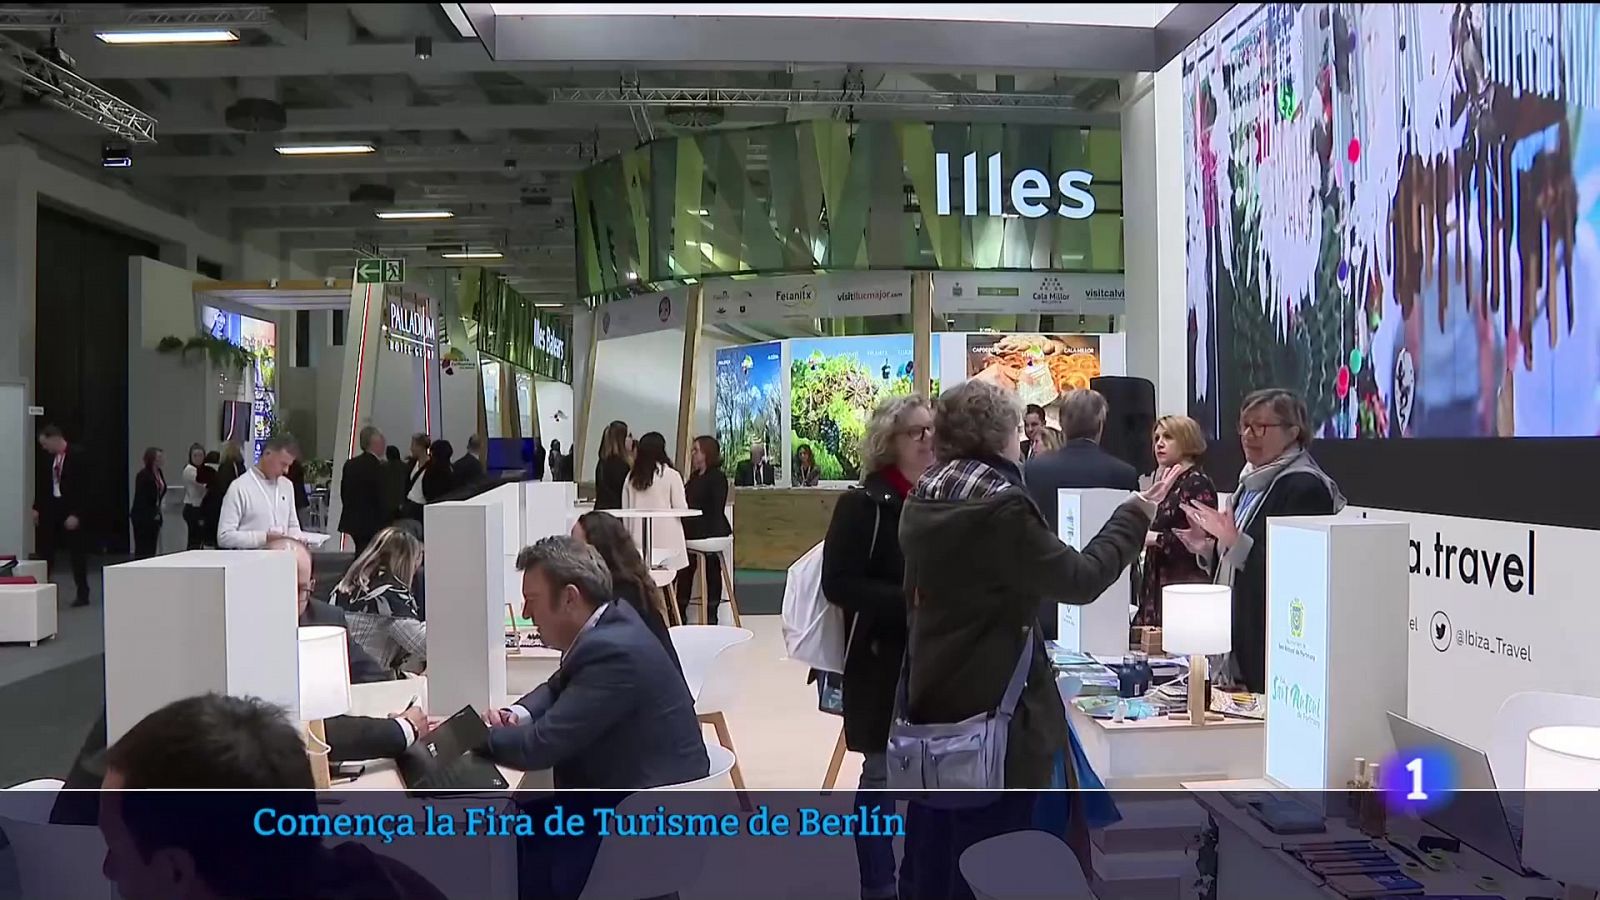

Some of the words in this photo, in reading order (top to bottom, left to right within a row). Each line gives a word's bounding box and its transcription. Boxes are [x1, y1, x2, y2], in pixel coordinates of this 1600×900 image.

[935, 151, 1097, 219] Illes
[776, 290, 812, 301] Felanitx
[1032, 292, 1048, 301] Cala
[1049, 292, 1070, 301] Millor
[1456, 629, 1532, 662] @Ibiza_Travel
